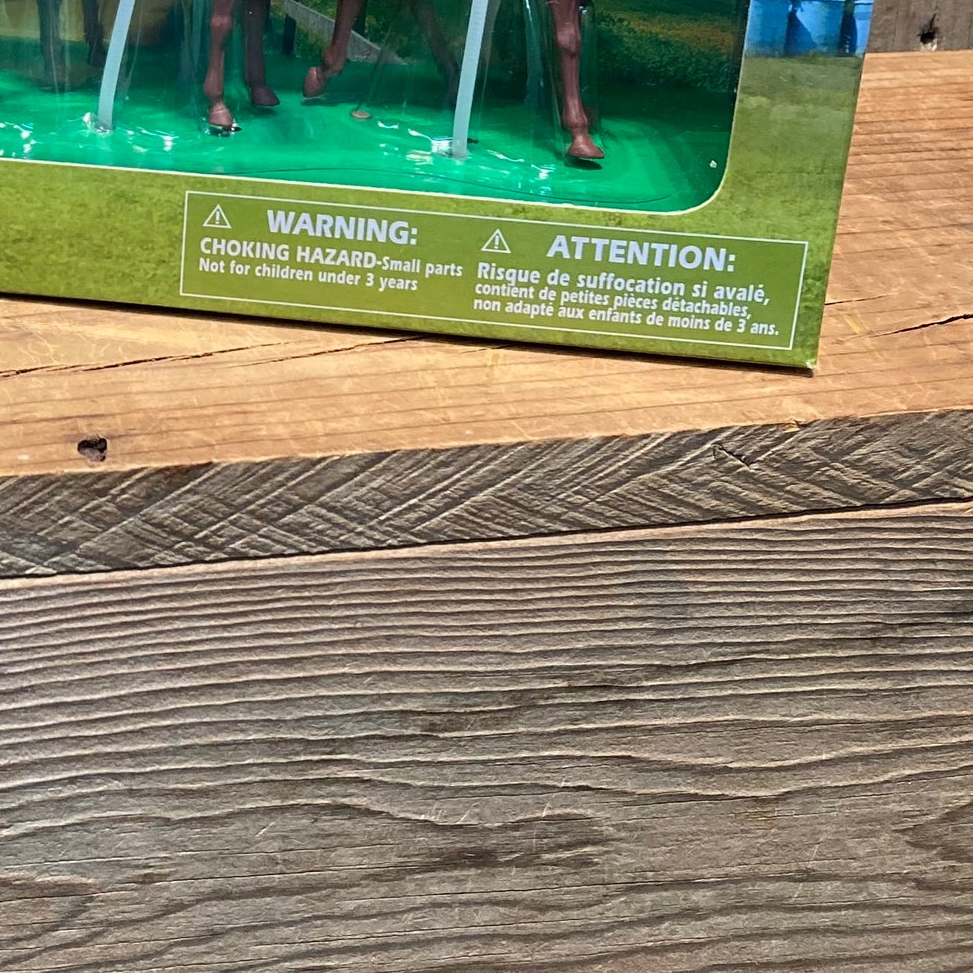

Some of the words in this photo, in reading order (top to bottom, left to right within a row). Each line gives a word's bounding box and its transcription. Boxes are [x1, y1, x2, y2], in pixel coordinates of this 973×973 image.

[267, 209, 418, 245] WARNING:
[200, 237, 290, 261] CHOKING
[297, 245, 421, 273] HAZARD-Small
[425, 262, 463, 278] parts
[546, 234, 736, 272] ATTENTION:
[198, 258, 225, 274] Not
[230, 260, 251, 275] for
[255, 263, 314, 282] children
[318, 268, 361, 286] under
[365, 273, 375, 287] 3
[379, 277, 418, 291] years
[477, 262, 540, 287] Risque
[546, 268, 571, 286] de
[577, 272, 686, 296] suffocation
[691, 280, 708, 298] si
[713, 284, 770, 306] avalé,
[473, 298, 501, 312] non
[505, 300, 555, 319] adapté
[557, 306, 585, 319] aux
[588, 307, 642, 324] enfants
[645, 311, 664, 326] de
[667, 314, 711, 330] moins
[714, 317, 733, 332] de
[736, 318, 746, 333] 3
[749, 322, 780, 335] ans.
[475, 282, 535, 299] contient
[538, 286, 557, 301] de
[560, 289, 610, 306] petites
[613, 293, 659, 310] pièces
[662, 297, 752, 319] détachables,
